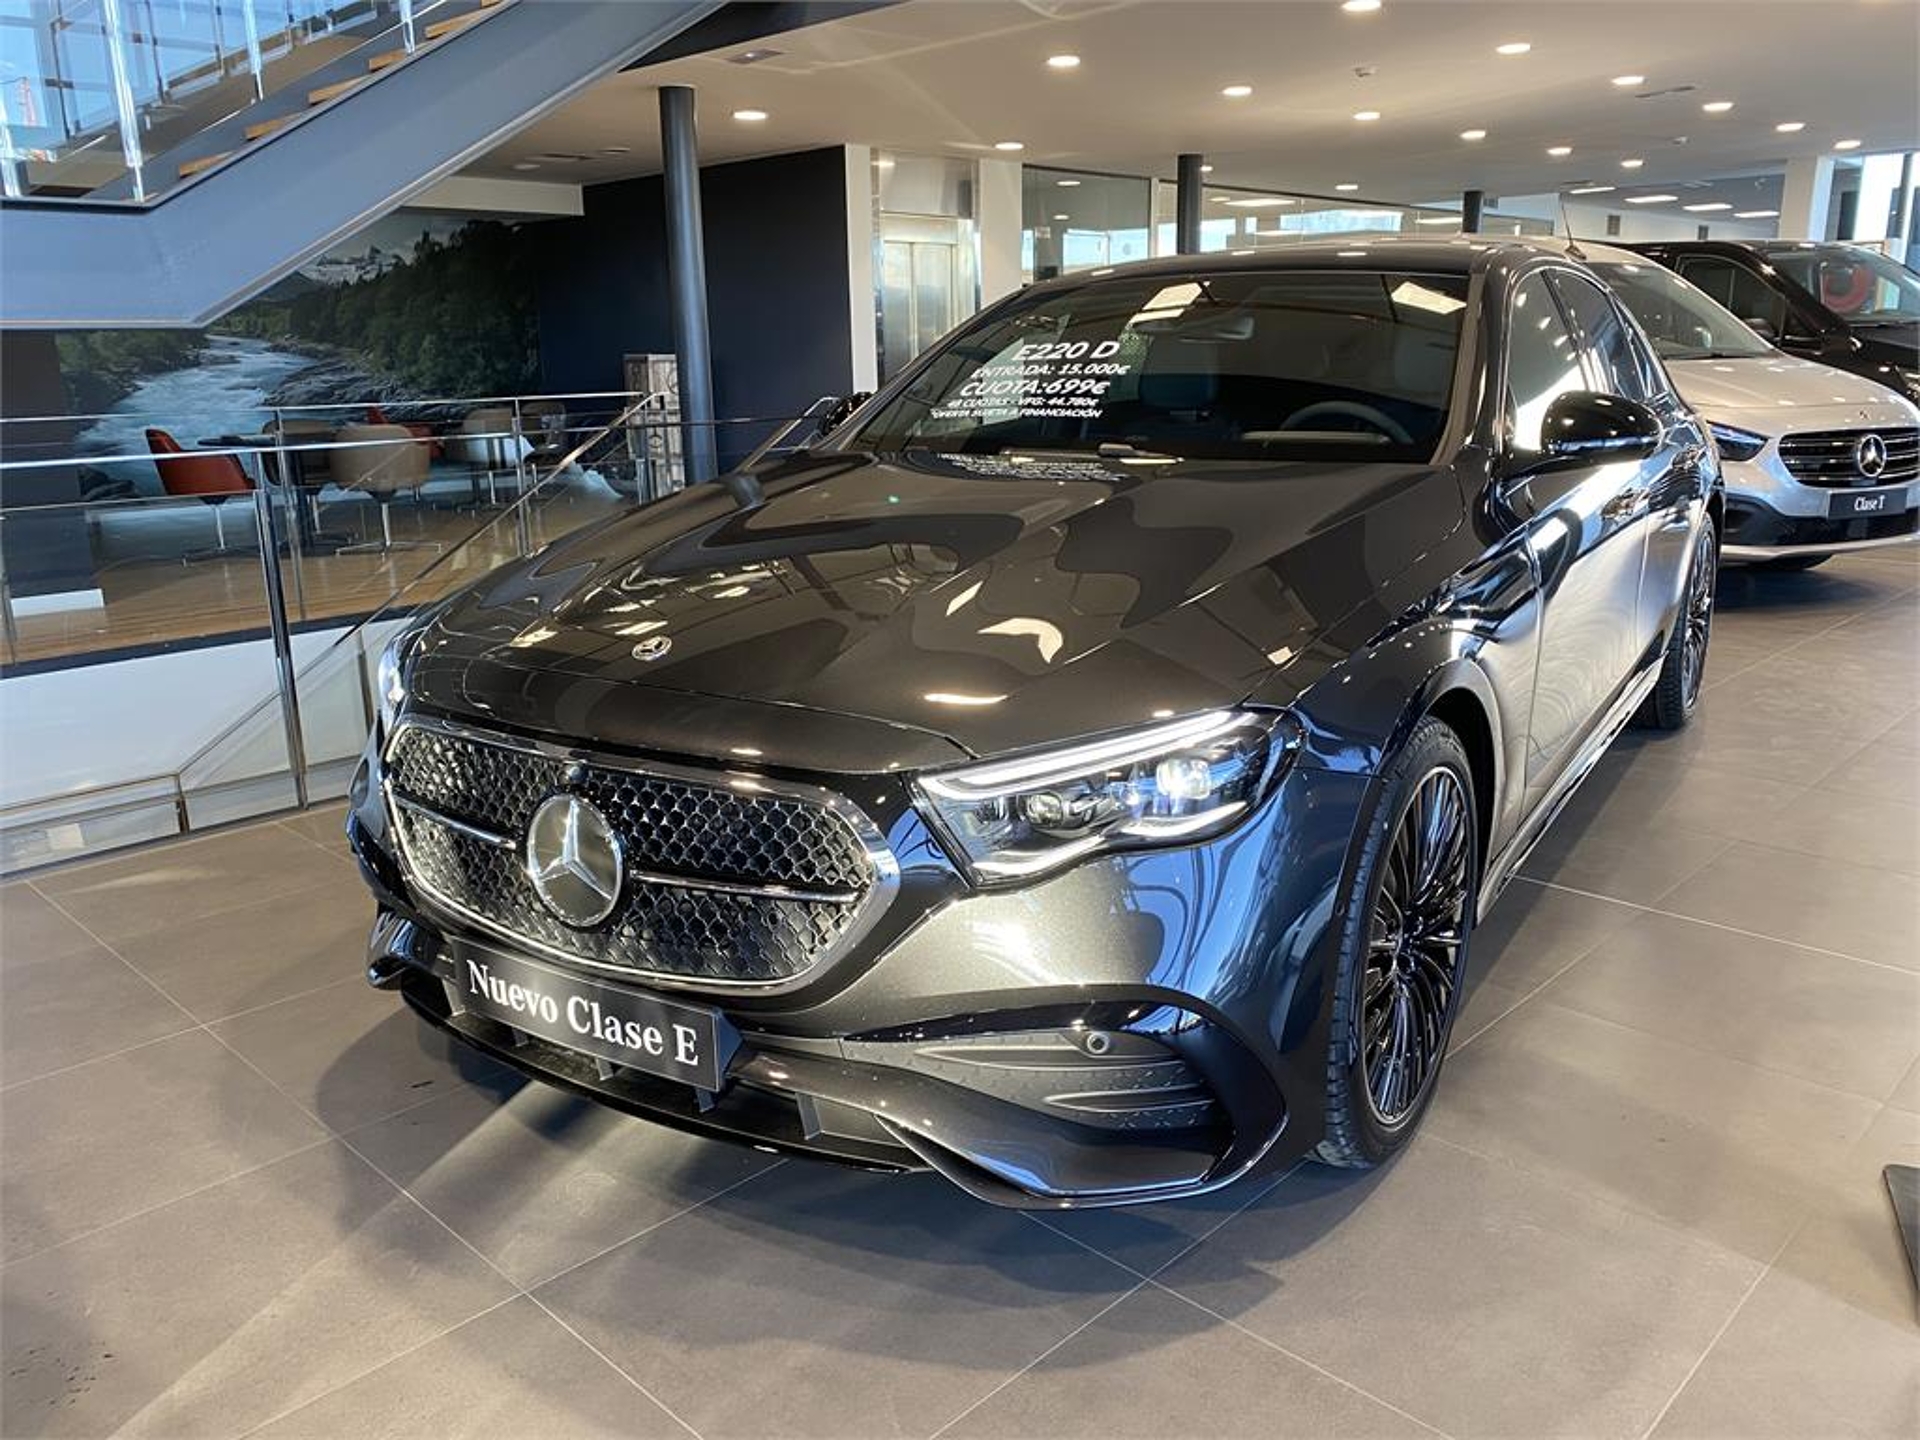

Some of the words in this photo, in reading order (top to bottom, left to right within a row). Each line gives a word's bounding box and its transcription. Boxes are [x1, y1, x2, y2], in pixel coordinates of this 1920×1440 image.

[1012, 341, 1089, 361] E220
[1090, 341, 1120, 359] D
[971, 363, 1055, 379] ENTRADA:
[1058, 363, 1131, 375] 15.000€
[466, 959, 558, 1023] Nuevo
[567, 995, 663, 1056] Clase
[672, 1023, 699, 1066] E
